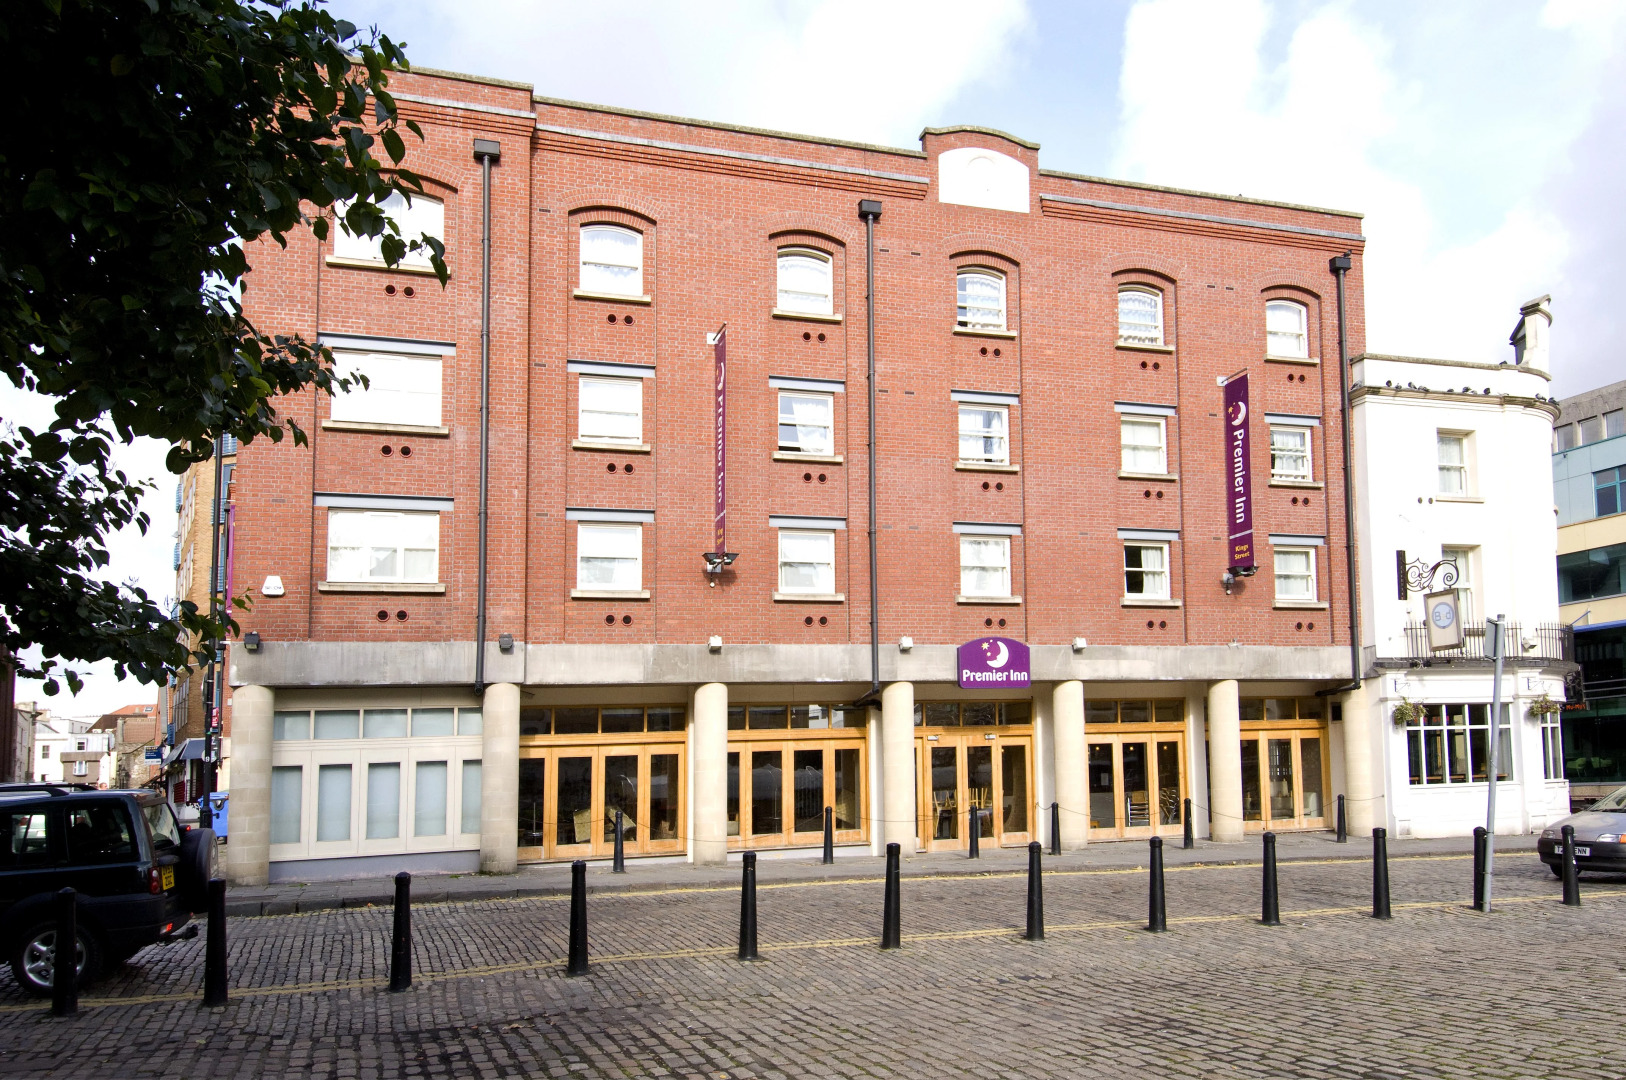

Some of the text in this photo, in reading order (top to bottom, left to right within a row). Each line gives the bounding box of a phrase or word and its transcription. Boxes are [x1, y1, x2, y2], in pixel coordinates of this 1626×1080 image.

[1233, 428, 1247, 524] Premier Inn
[1235, 544, 1249, 552] Kings
[1234, 551, 1250, 560] Street
[962, 669, 1028, 682] Premier Inn
